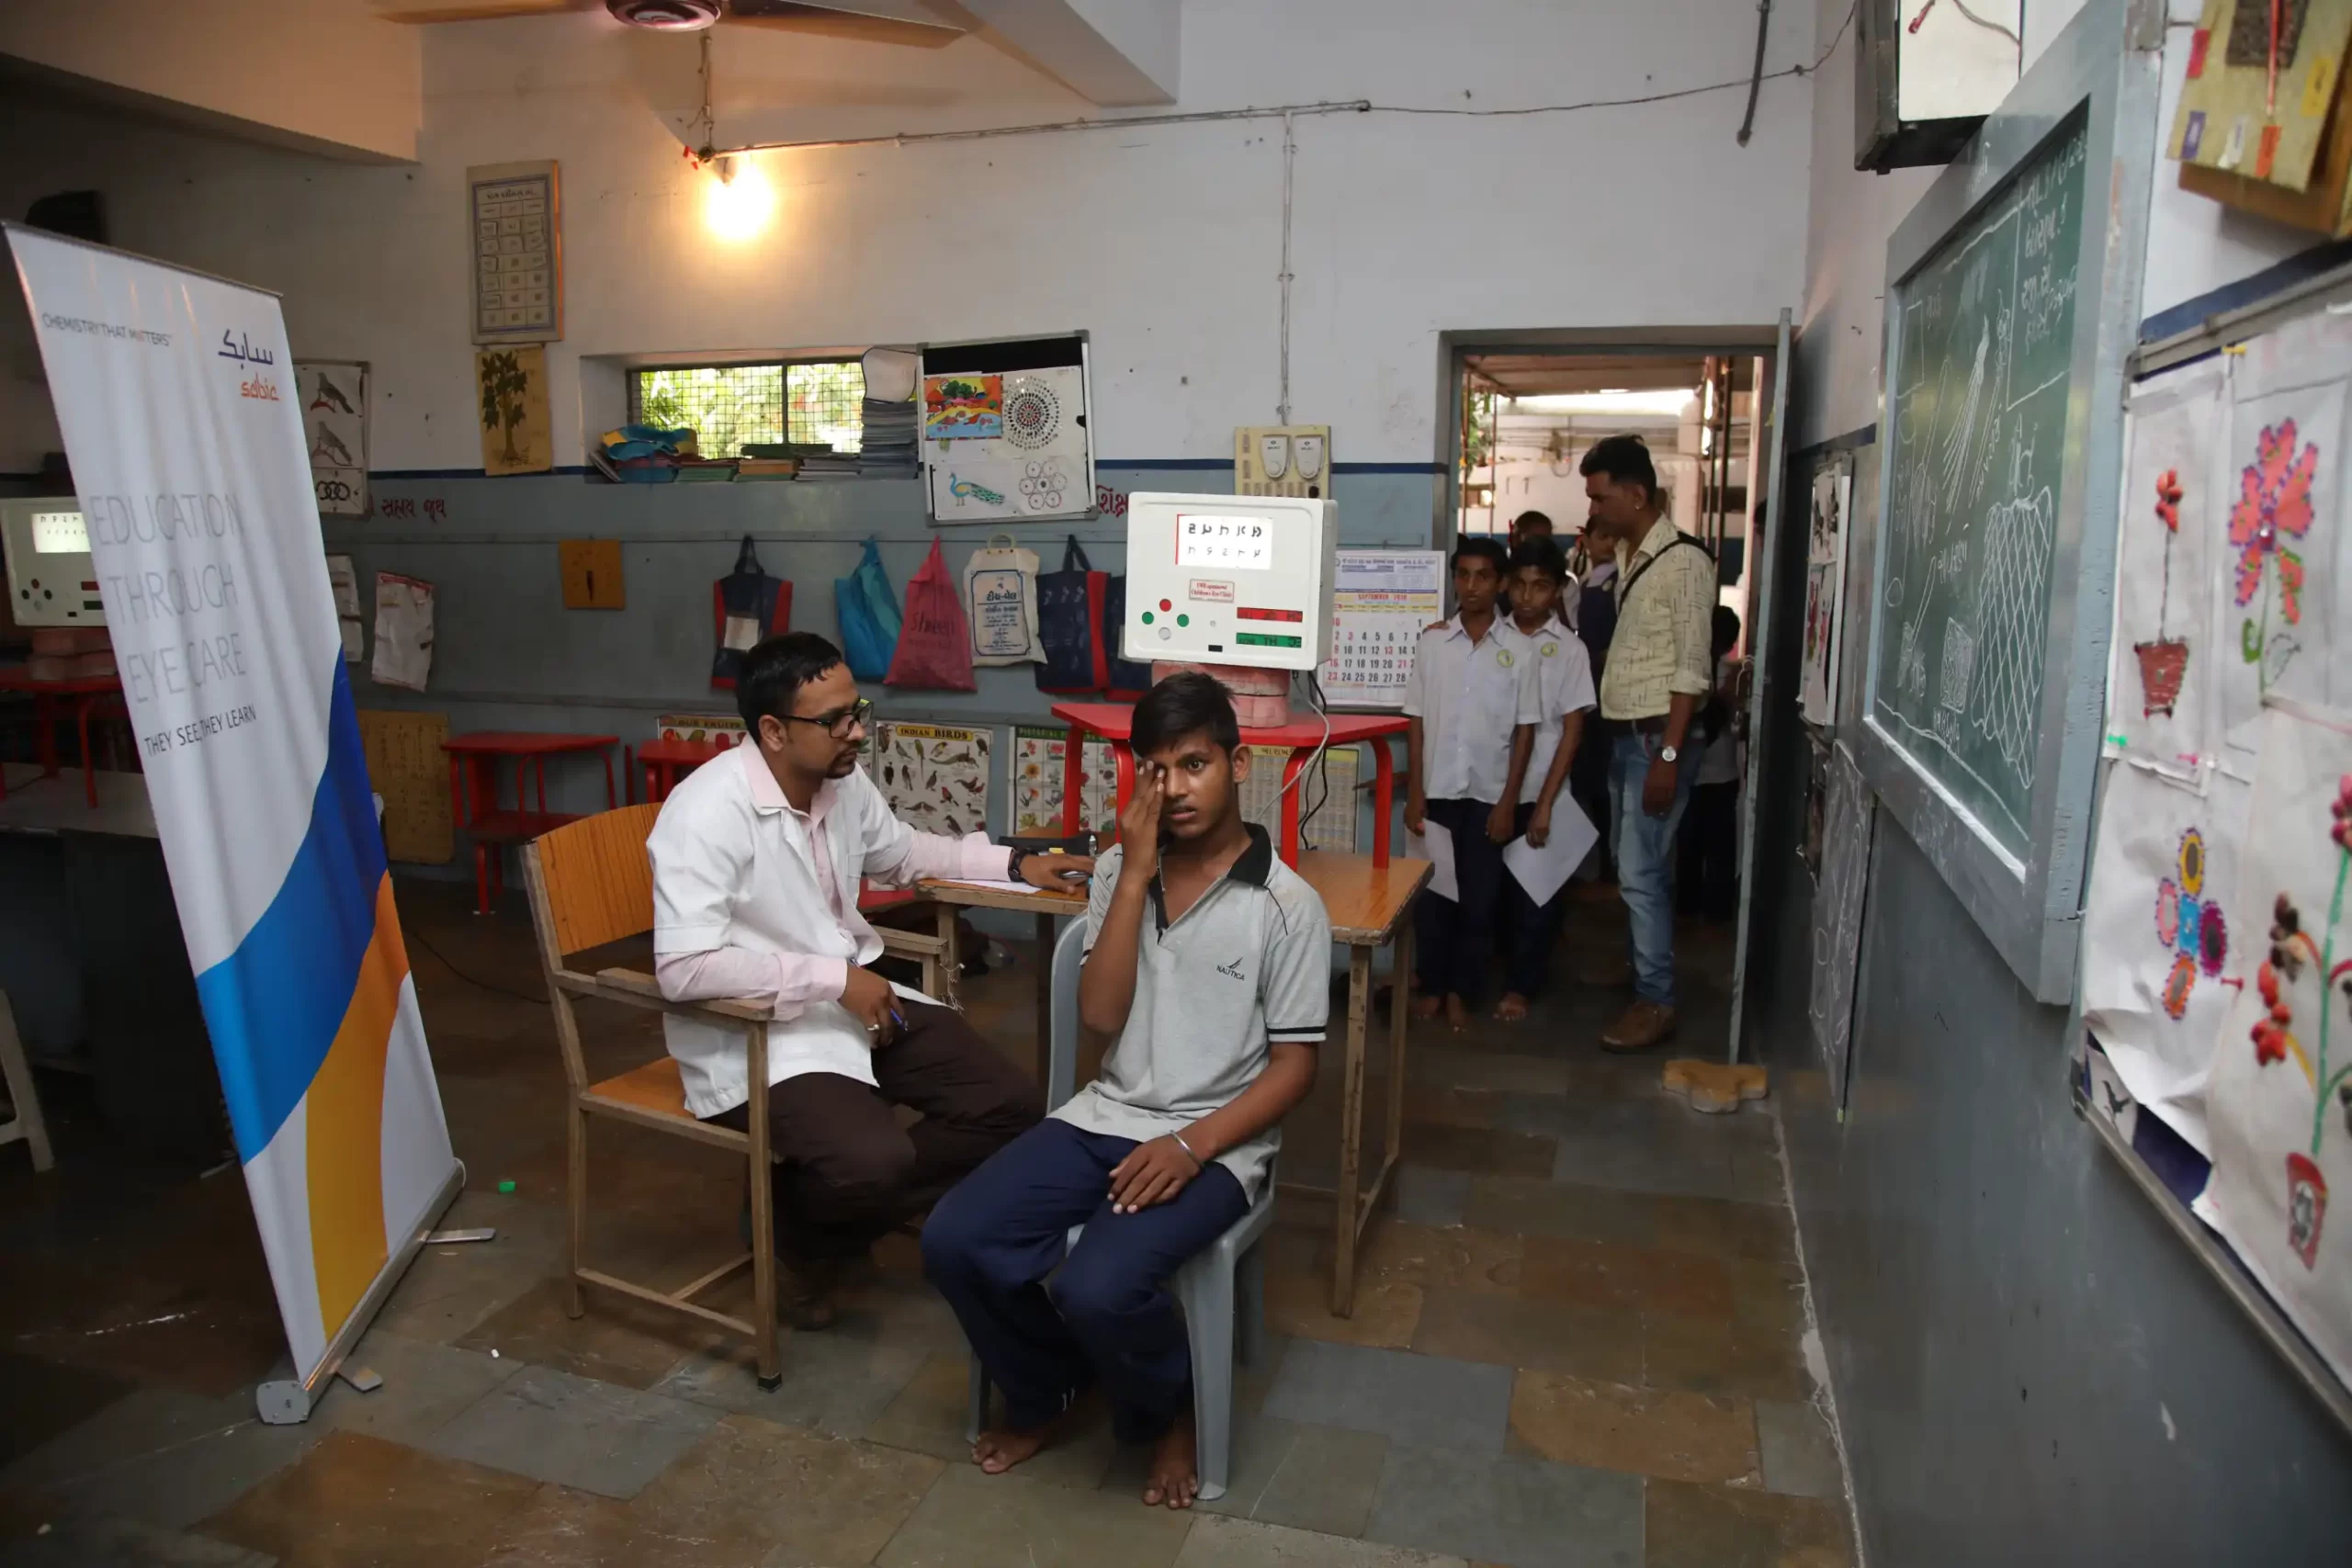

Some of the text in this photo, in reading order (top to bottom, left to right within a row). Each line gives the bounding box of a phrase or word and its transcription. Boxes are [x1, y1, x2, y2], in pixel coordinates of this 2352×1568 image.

[41, 312, 99, 334] CHEMISTRY
[99, 323, 127, 338] THAT
[218, 329, 274, 370] سابك
[241, 372, 279, 401] sabic
[90, 493, 245, 546] EDUCATION
[107, 564, 238, 625] THROUGH
[1335, 631, 1340, 640] 2
[1348, 631, 1353, 640] 3
[1362, 632, 1367, 641] 4
[1375, 632, 1381, 641] 5
[1388, 632, 1394, 641] 6
[1404, 632, 1408, 641] 7
[1334, 645, 1340, 654] 9
[1344, 646, 1352, 655] 10
[1359, 646, 1366, 655] 11
[1372, 646, 1380, 655] 12
[1385, 646, 1393, 655] 13
[1398, 646, 1408, 655] 14
[127, 632, 247, 704] EYE CARE
[1328, 671, 1406, 682] 23 24 25 26 27 28
[1329, 659, 1339, 668] 16
[1344, 659, 1352, 668] 17
[1357, 659, 1365, 669] 18
[1370, 659, 1379, 669] 19
[1383, 659, 1393, 669] 20
[1397, 659, 1407, 669] 21
[144, 731, 172, 757] THEY
[199, 713, 223, 738] THEY
[225, 705, 257, 728] LEARN
[900, 728, 968, 739] INDIAN BIRDS
[1216, 964, 1245, 981] NAUTICA
